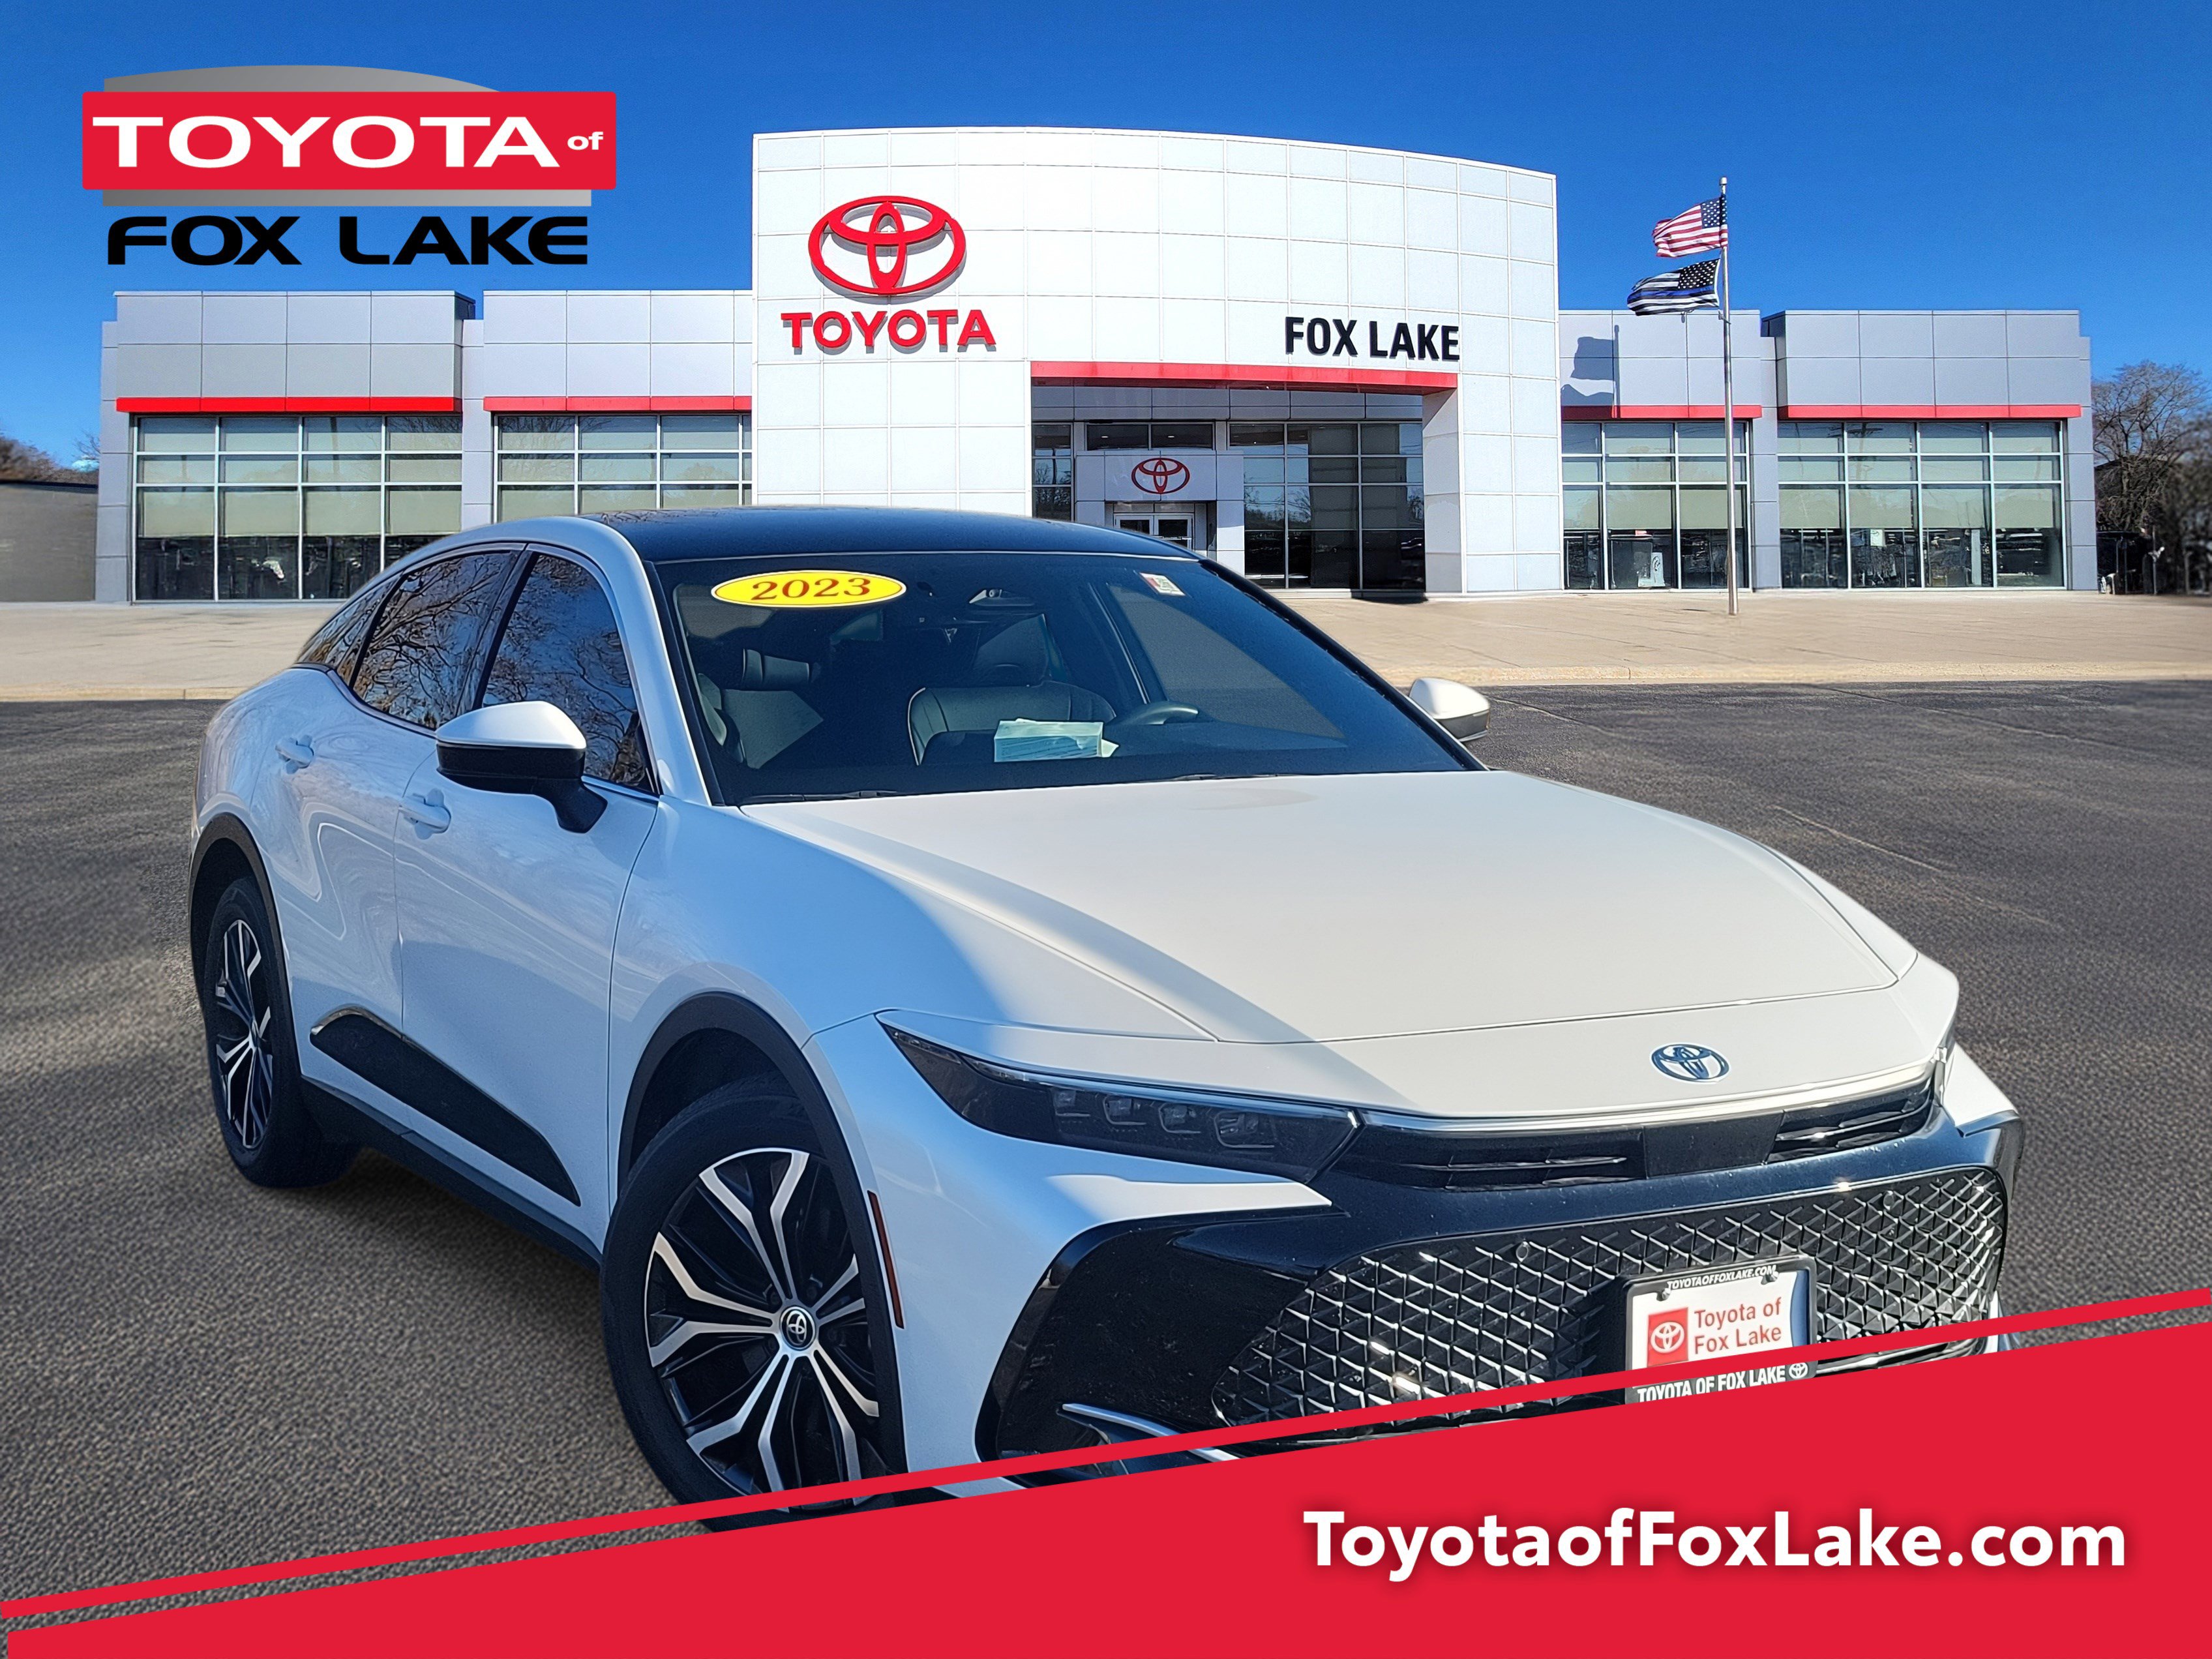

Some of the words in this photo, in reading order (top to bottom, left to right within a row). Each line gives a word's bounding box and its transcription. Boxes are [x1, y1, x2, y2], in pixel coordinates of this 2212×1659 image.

[781, 309, 996, 351] TOYOTA
[1285, 316, 1358, 357] FOX
[1369, 321, 1460, 361] LAKE
[751, 577, 871, 601] 2023
[1666, 1264, 1776, 1291] TOYOTAOFFOXLAKE.COM
[1694, 1304, 1756, 1330] Toyota
[1763, 1296, 1782, 1318] of
[1694, 1335, 1729, 1355] Fox
[1736, 1325, 1782, 1347] Lake
[1637, 1380, 1692, 1403] TOYOTA
[1696, 1375, 1715, 1395] OF
[1718, 1370, 1746, 1392] FOX
[1749, 1364, 1786, 1388] LAKE
